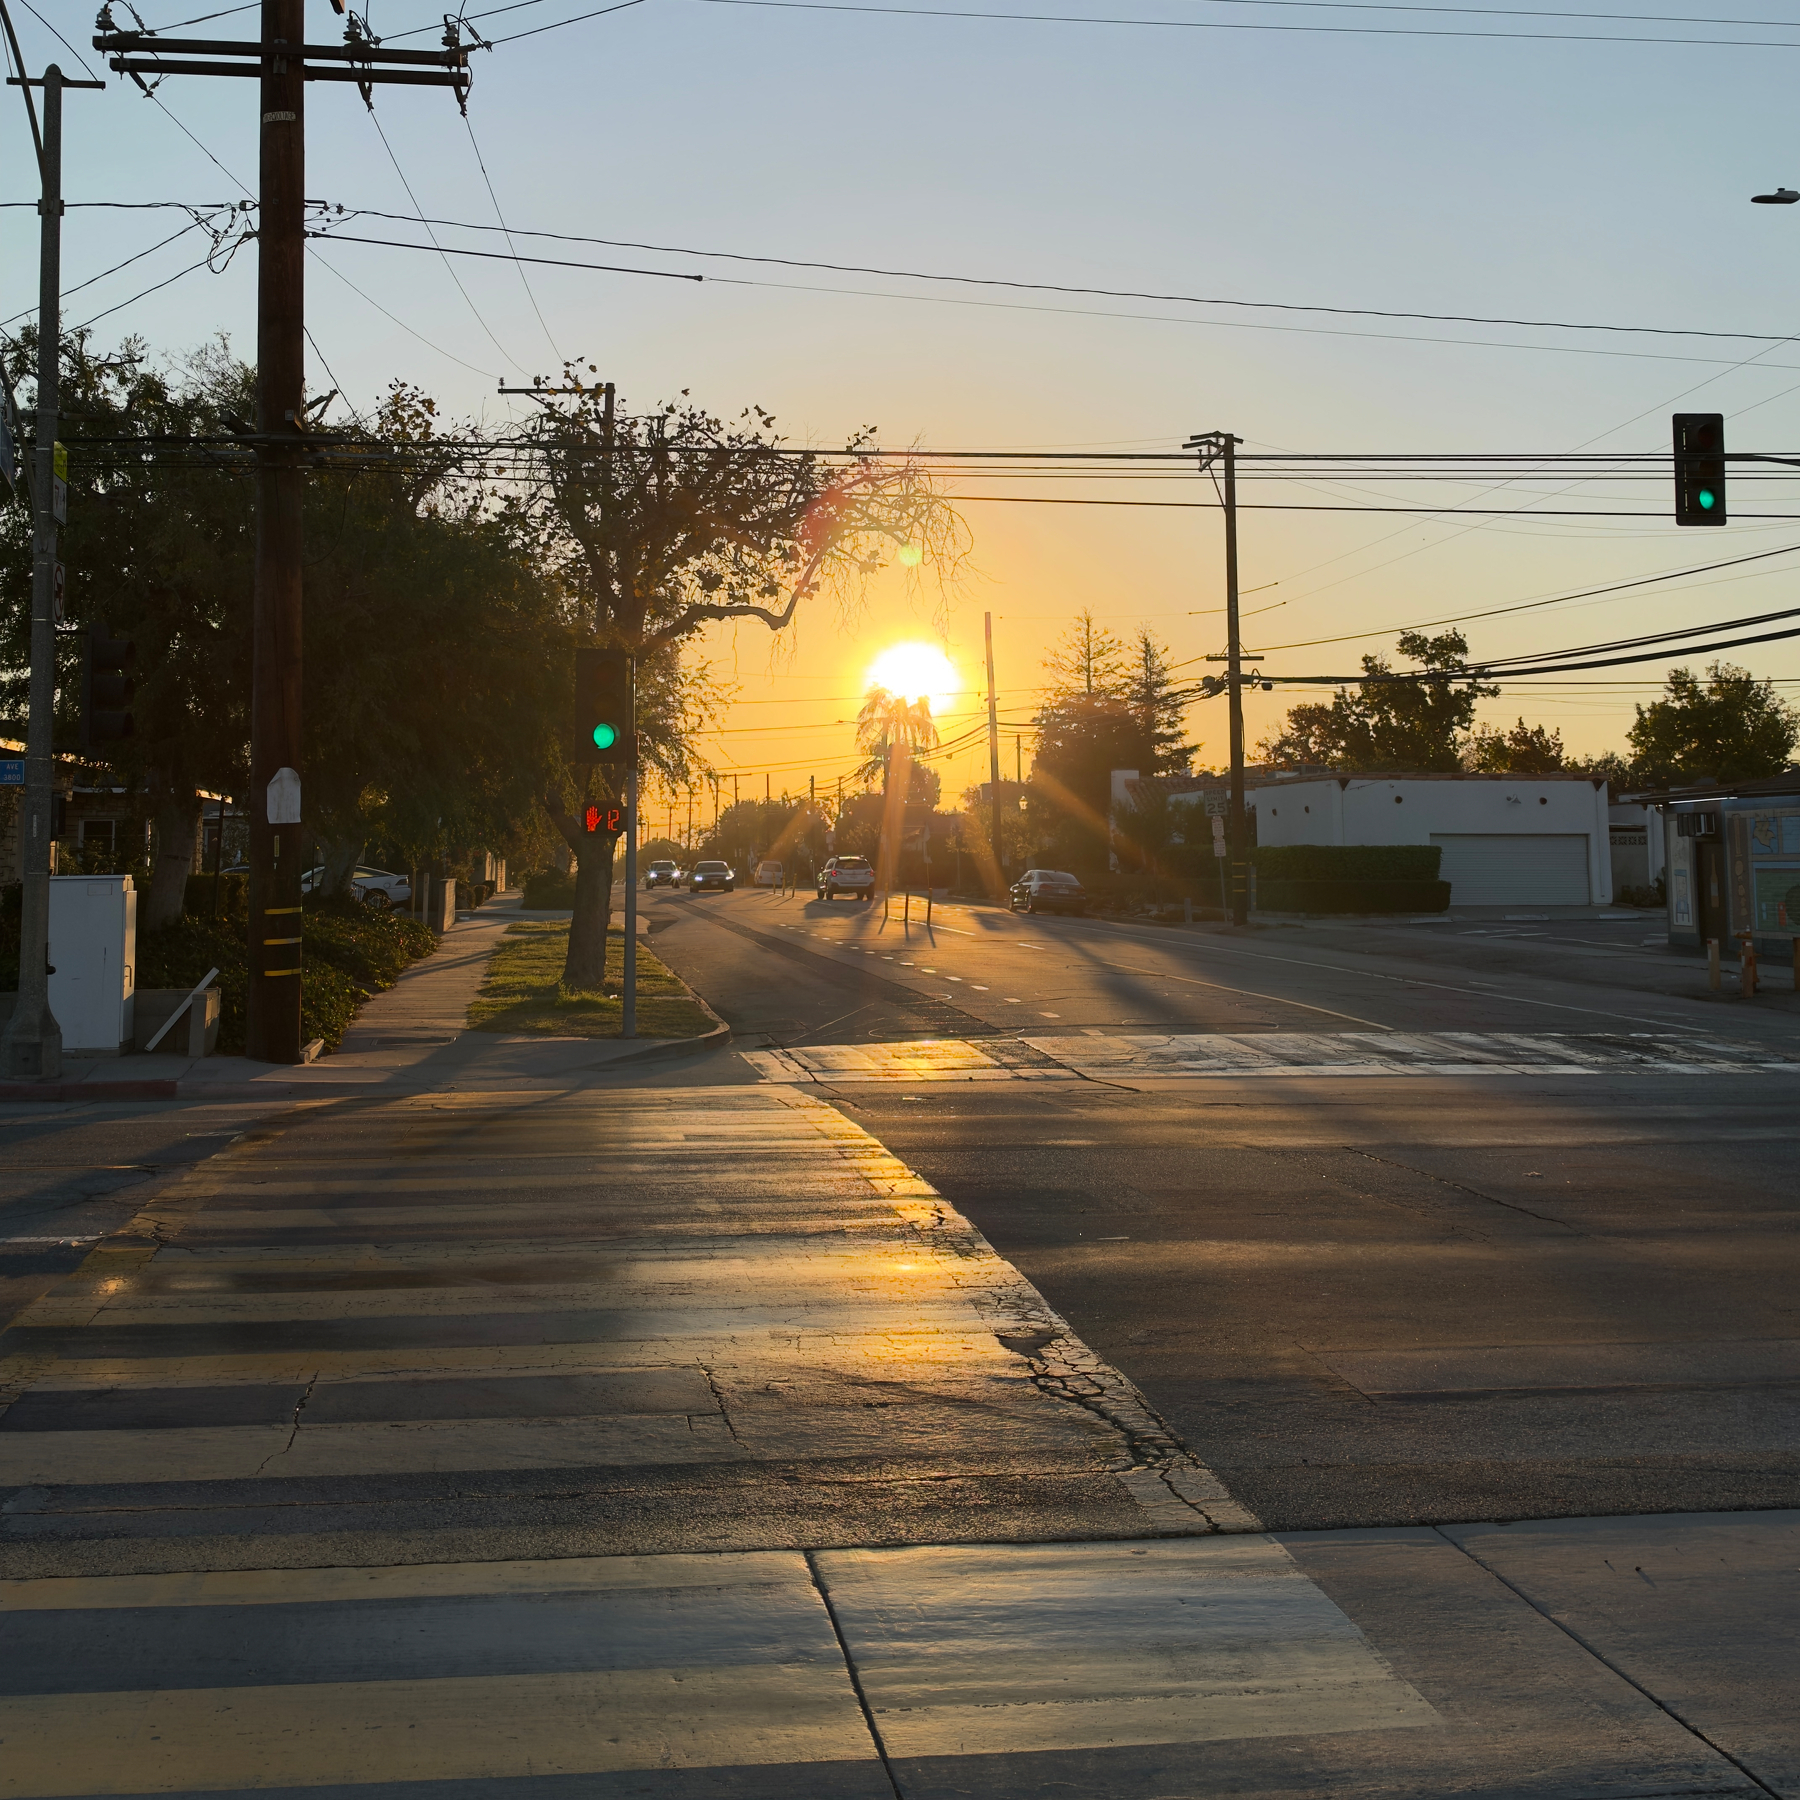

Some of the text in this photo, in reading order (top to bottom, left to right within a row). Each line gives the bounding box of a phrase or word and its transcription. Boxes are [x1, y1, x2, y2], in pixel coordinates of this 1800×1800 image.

[3, 773, 21, 781] 3800
[1207, 802, 1226, 815] 25
[607, 809, 620, 831] 12
